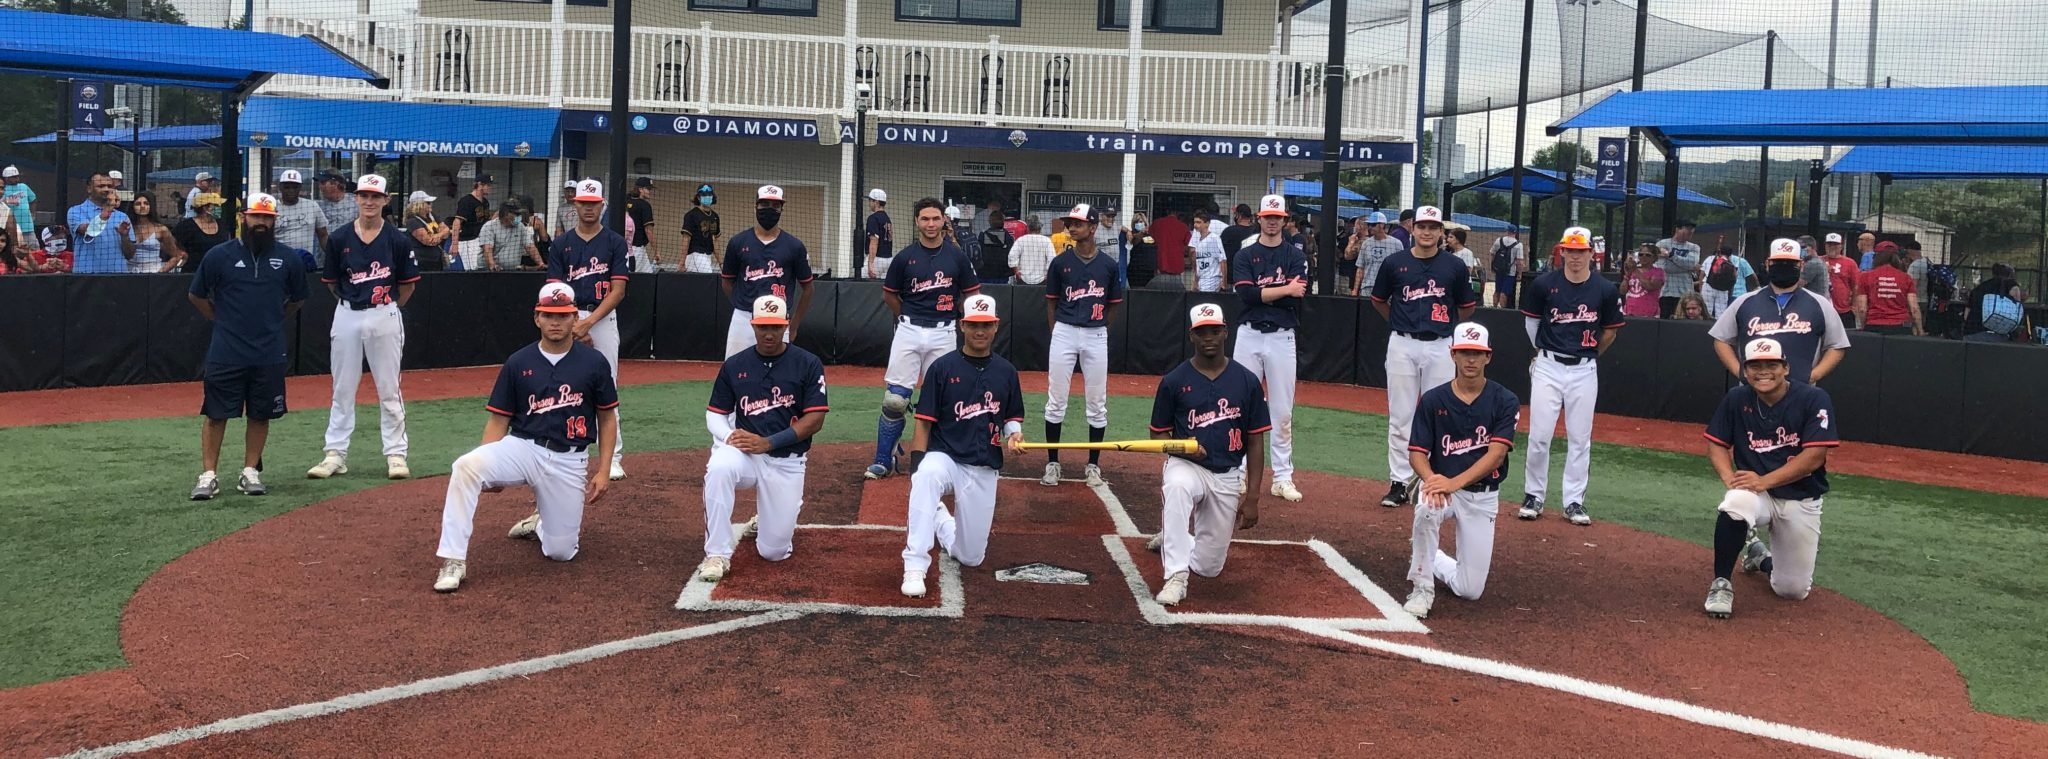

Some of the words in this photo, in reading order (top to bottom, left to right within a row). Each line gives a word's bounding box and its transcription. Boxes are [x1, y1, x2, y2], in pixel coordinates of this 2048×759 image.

[78, 102, 99, 110] FIELD
[84, 112, 93, 125] 4
[673, 116, 948, 143] @DIAMONDAONNJ
[284, 135, 389, 151] TOURNAMENT
[393, 140, 499, 155] INFORMATION
[1087, 135, 1165, 151] train.
[1181, 140, 1311, 158] compete.
[1340, 142, 1383, 160] in.
[1605, 169, 1614, 181] 2
[1033, 194, 1053, 205] THE
[1107, 198, 1145, 208] MU
[595, 281, 611, 300] 17
[761, 300, 779, 313] JB
[971, 299, 989, 312] JB
[1198, 306, 1215, 317] JB
[1462, 327, 1481, 341] JB
[1747, 316, 1780, 336] Jersey
[1753, 341, 1772, 353] JB
[527, 393, 555, 416] Jersey
[740, 395, 769, 417] Jersey
[954, 400, 981, 421] Jersey
[1188, 409, 1216, 430] Jersey
[1442, 434, 1472, 456] Jersey
[1747, 431, 1773, 450] Jersey
